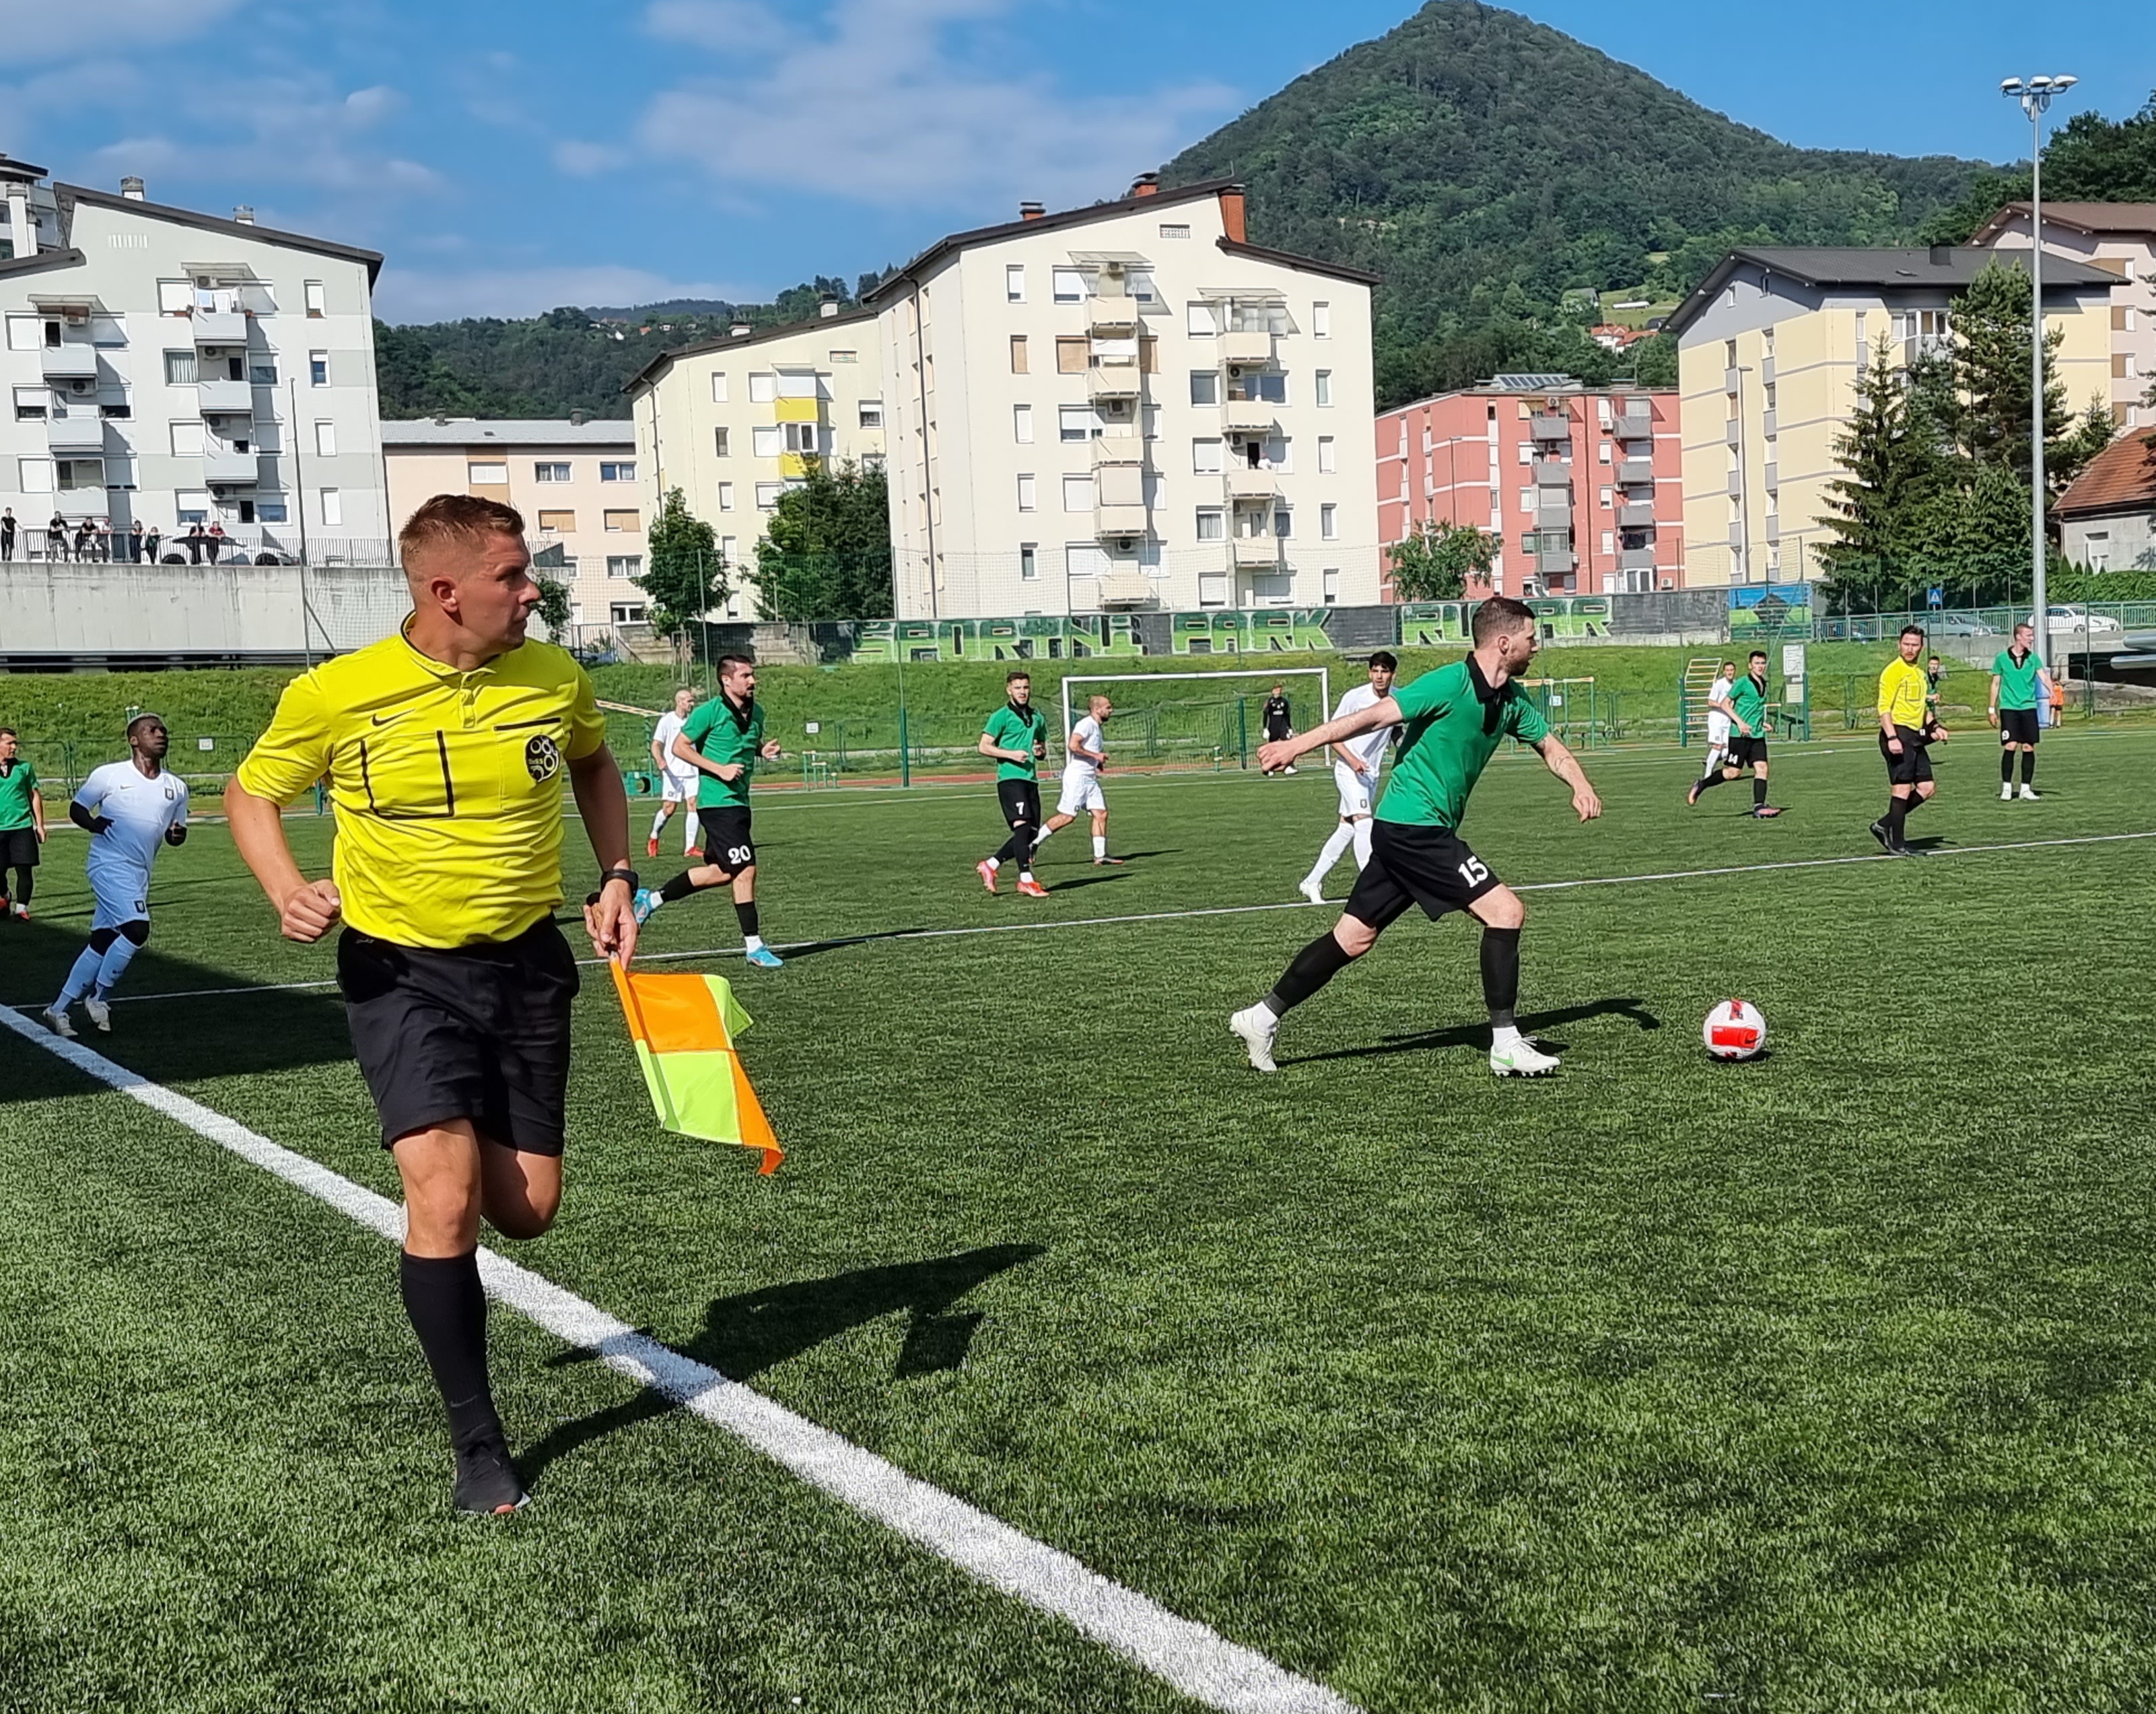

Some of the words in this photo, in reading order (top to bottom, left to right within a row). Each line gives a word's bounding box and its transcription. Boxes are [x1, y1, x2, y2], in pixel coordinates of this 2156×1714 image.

[1170, 609, 1335, 654] PARK
[1401, 594, 1614, 647] RUAR
[1016, 802, 1024, 815] 7
[728, 845, 751, 864] 20
[1458, 855, 1488, 888] 15
